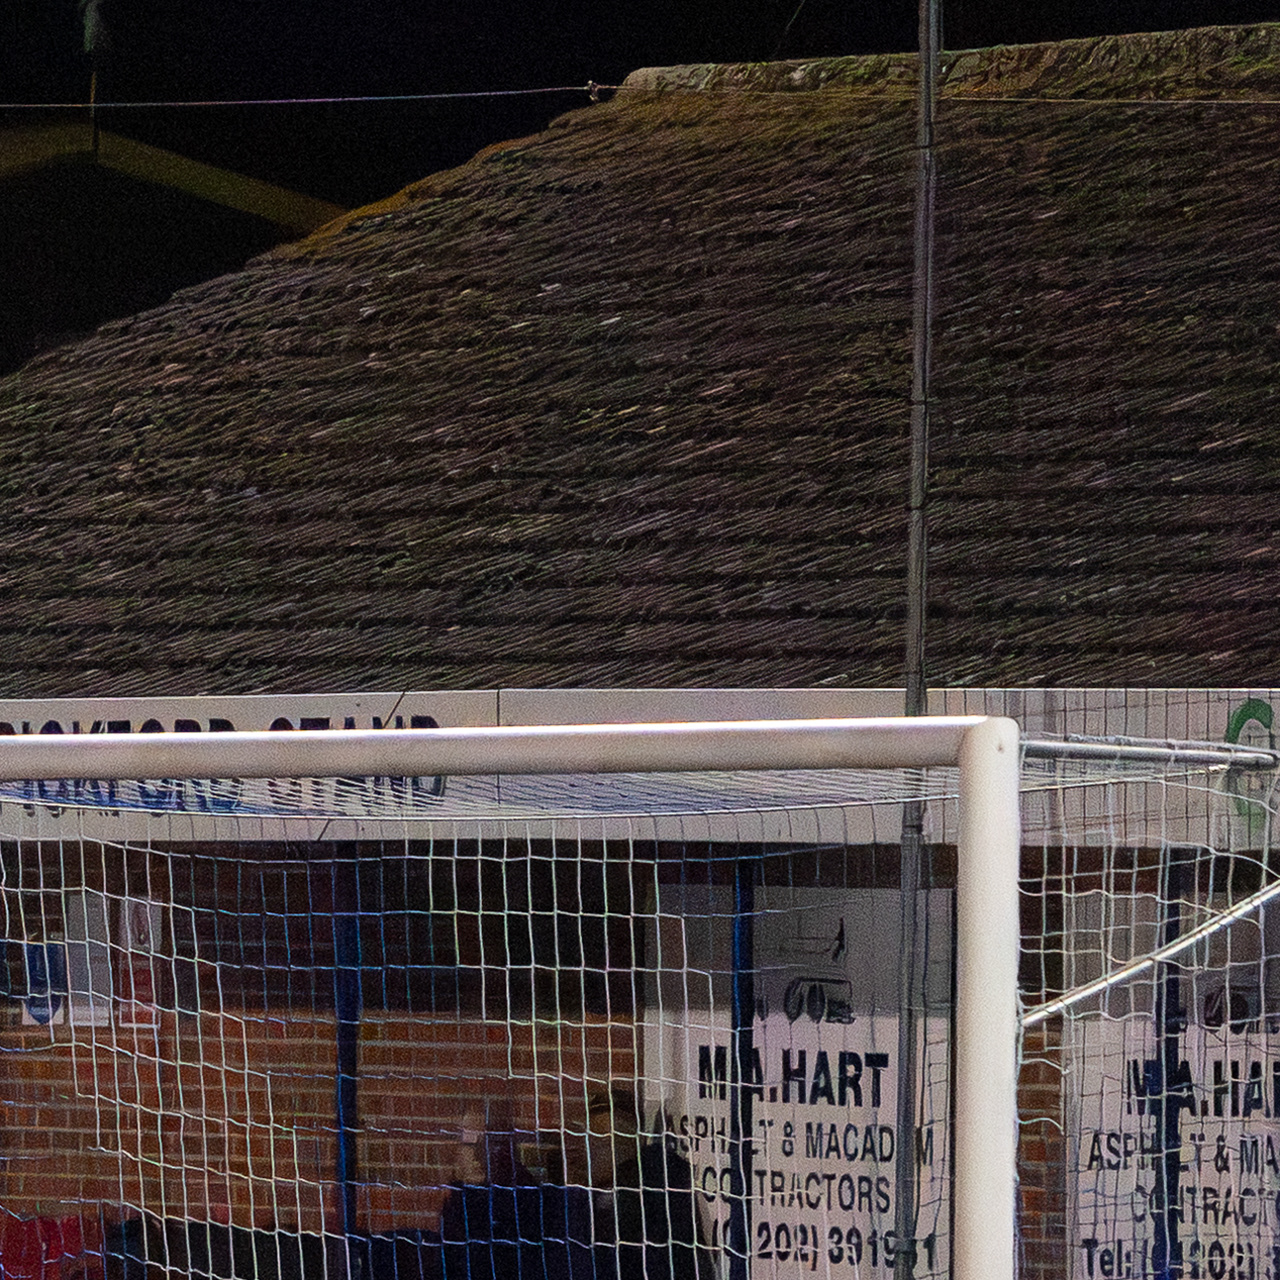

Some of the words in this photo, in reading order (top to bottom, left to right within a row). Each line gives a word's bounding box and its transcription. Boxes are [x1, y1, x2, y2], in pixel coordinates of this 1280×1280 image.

[782, 1121, 794, 1158] &
[805, 1122, 934, 1166] MACADM
[1214, 1134, 1230, 1174] &
[702, 1166, 891, 1214] COTRACTORS
[828, 1226, 935, 1272] 39191
